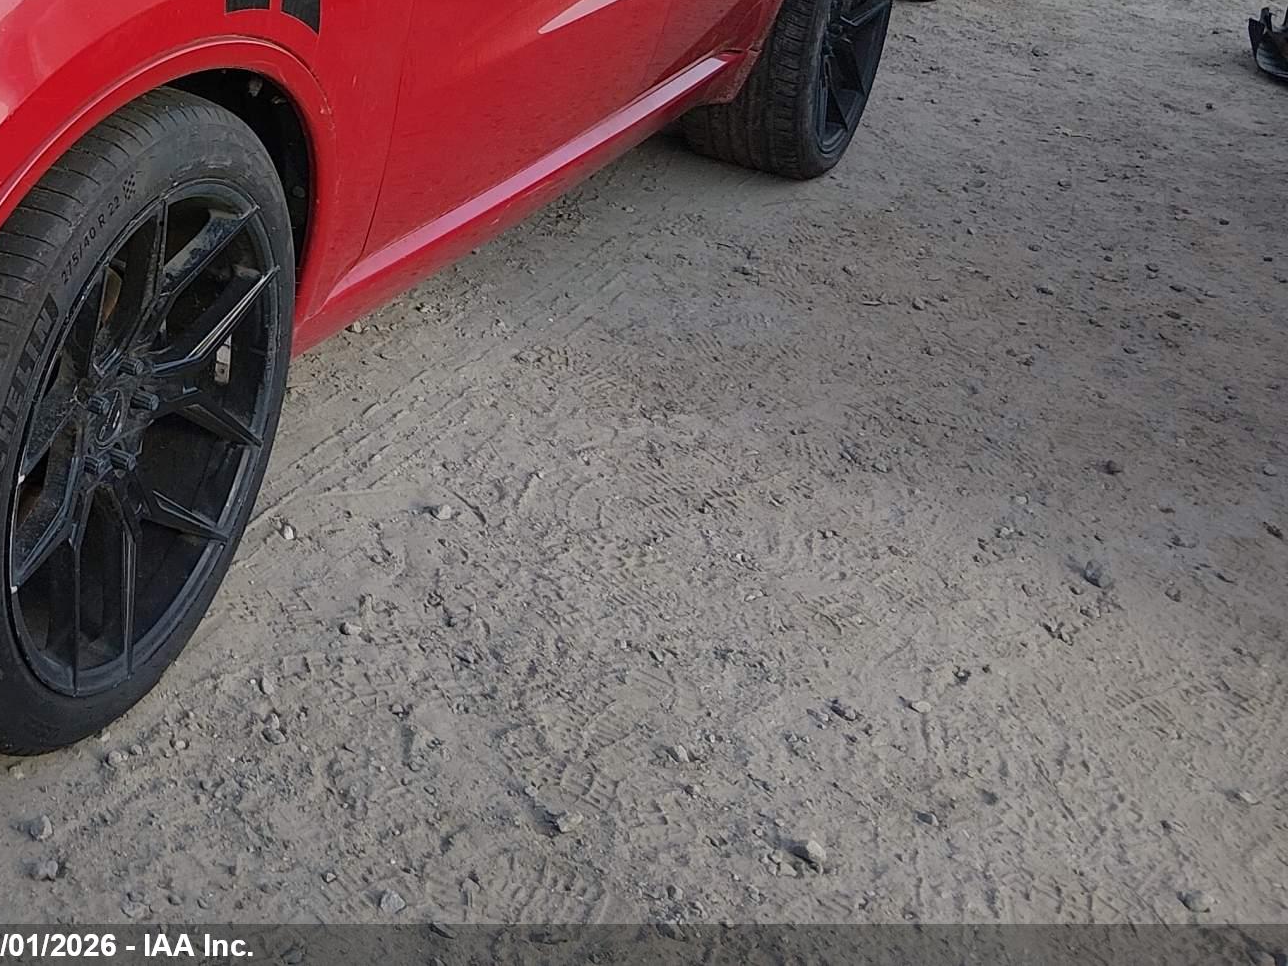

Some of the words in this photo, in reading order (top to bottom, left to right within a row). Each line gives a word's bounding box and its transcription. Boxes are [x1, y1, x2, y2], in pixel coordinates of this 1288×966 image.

[60, 226, 97, 286] 275/40
[97, 212, 107, 229] R
[106, 195, 121, 217] 22
